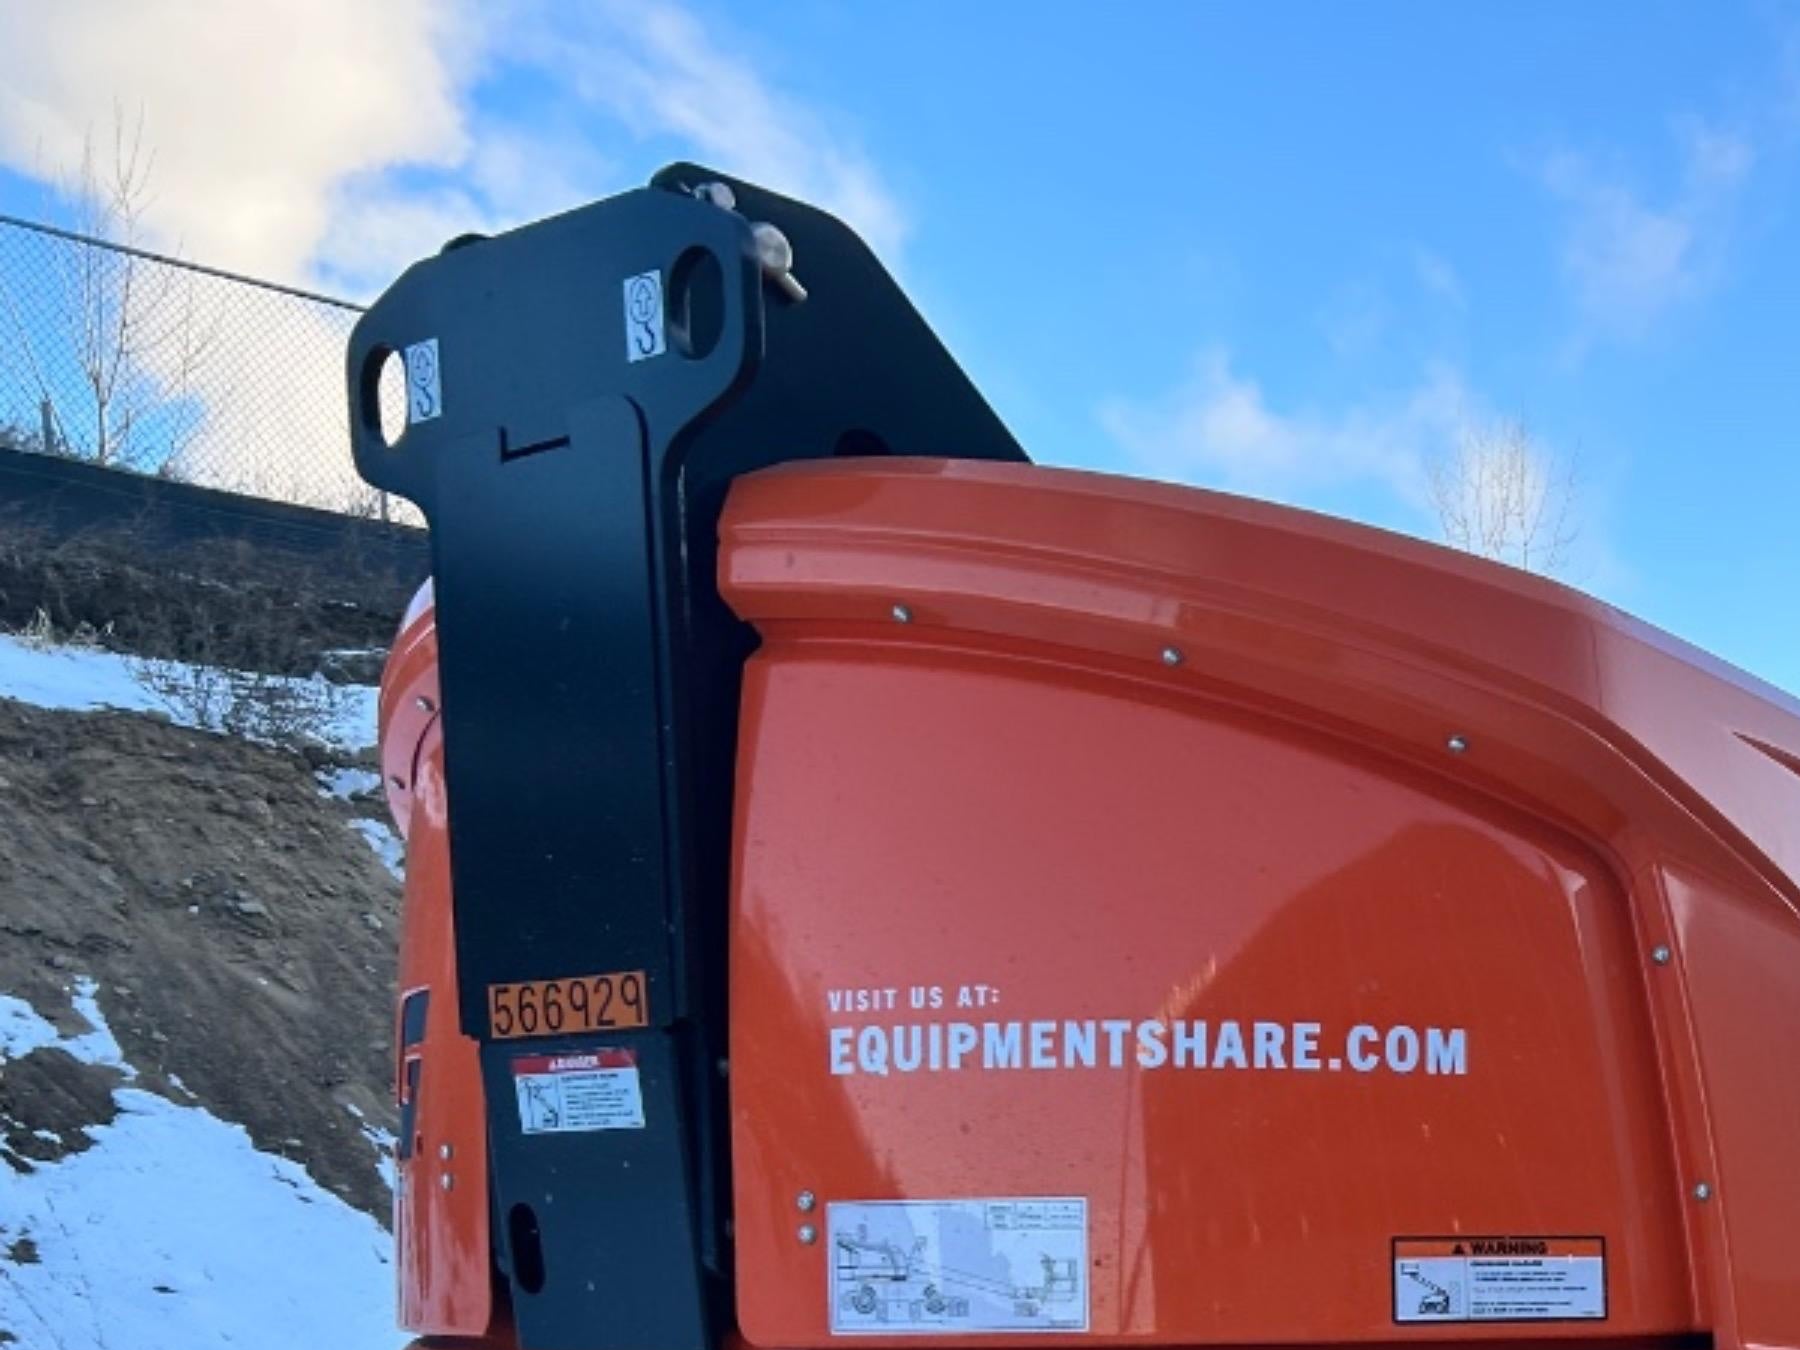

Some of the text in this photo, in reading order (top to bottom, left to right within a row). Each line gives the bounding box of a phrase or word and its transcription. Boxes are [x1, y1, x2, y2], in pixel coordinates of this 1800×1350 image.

[494, 975, 642, 1034] 566929
[828, 985, 1000, 1012] VISIT US AT:
[829, 1020, 1468, 1077] EQUIPMENTSHARE.COM
